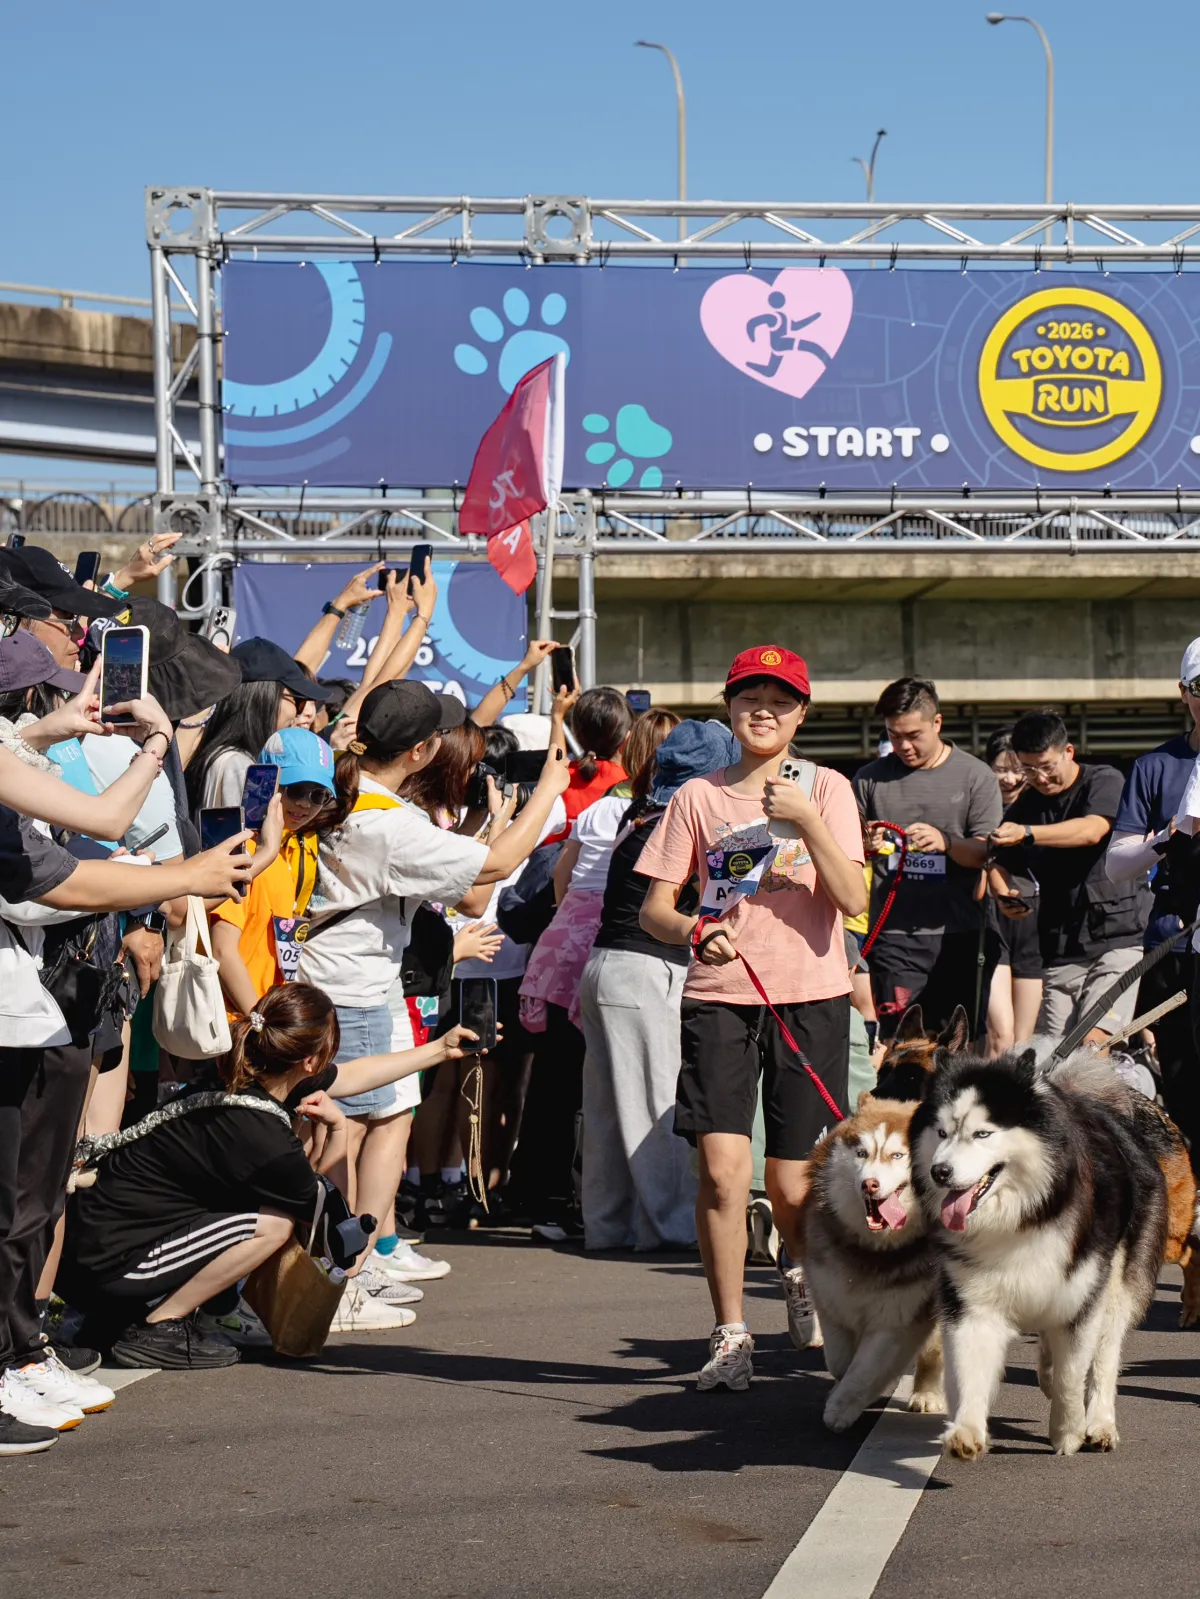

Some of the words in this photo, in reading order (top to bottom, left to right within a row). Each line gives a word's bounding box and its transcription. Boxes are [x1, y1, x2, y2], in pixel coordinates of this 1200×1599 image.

[1047, 322, 1094, 340] 2026
[1012, 345, 1130, 376] TOYOTA
[1037, 384, 1105, 413] RUN
[782, 426, 921, 457] START
[346, 635, 434, 666] 26
